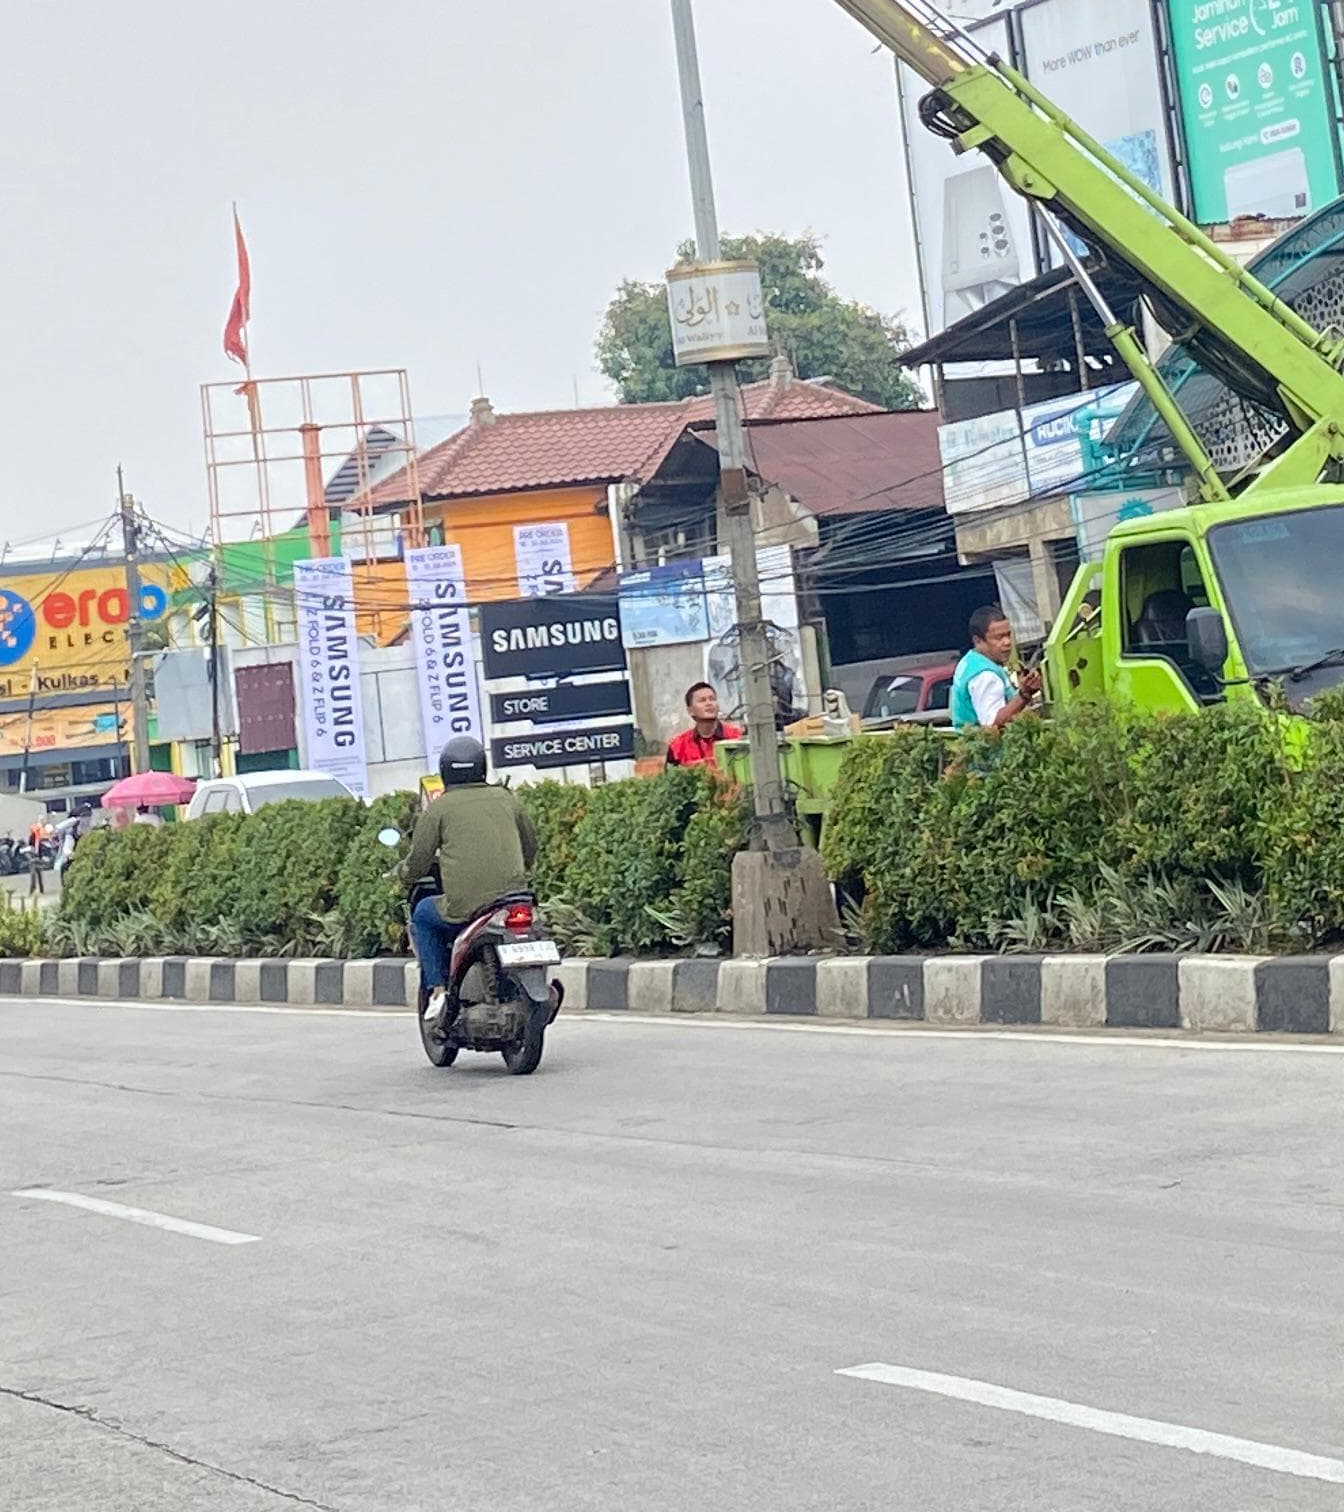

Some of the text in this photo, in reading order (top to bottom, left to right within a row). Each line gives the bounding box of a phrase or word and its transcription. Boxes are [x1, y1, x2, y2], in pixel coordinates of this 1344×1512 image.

[1271, 7, 1299, 29] Jam
[1195, 16, 1249, 50] Service
[427, 551, 455, 561] ORDER
[308, 620, 321, 655] FOLD
[492, 618, 618, 654] SAMSUNG
[323, 595, 355, 747] SAMSUNG
[435, 583, 472, 734] SAMSUNG
[37, 673, 99, 691] Kulkas
[312, 686, 324, 695] Z
[314, 697, 326, 724] FLIP
[504, 697, 548, 715] STORE
[504, 732, 621, 760] SERVICE CENTER
